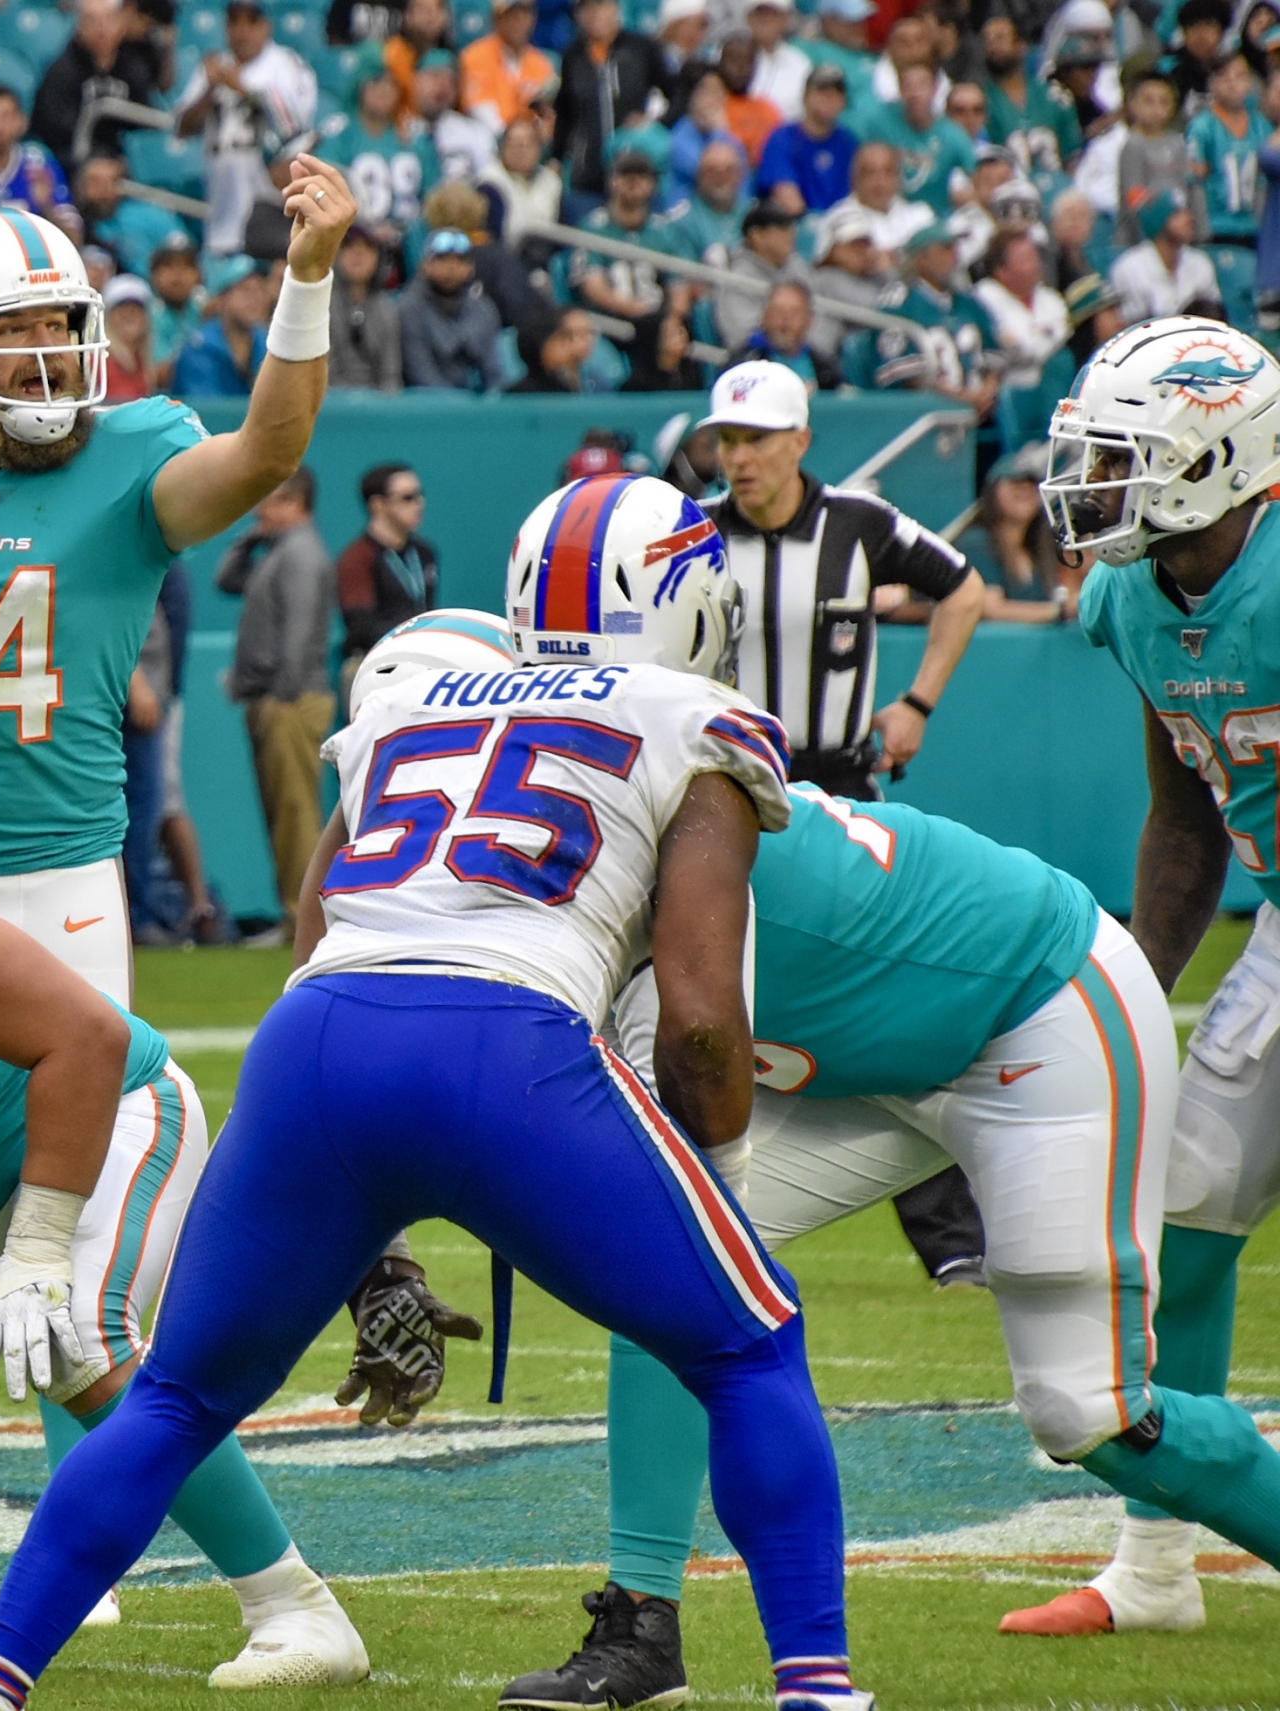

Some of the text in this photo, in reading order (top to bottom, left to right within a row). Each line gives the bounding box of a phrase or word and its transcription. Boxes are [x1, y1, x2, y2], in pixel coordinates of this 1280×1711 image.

[29, 272, 61, 284] MIAMI
[537, 640, 591, 656] BILLS
[423, 665, 630, 707] HUGHES
[1164, 675, 1247, 700] Dolphins
[319, 717, 644, 907] 55
